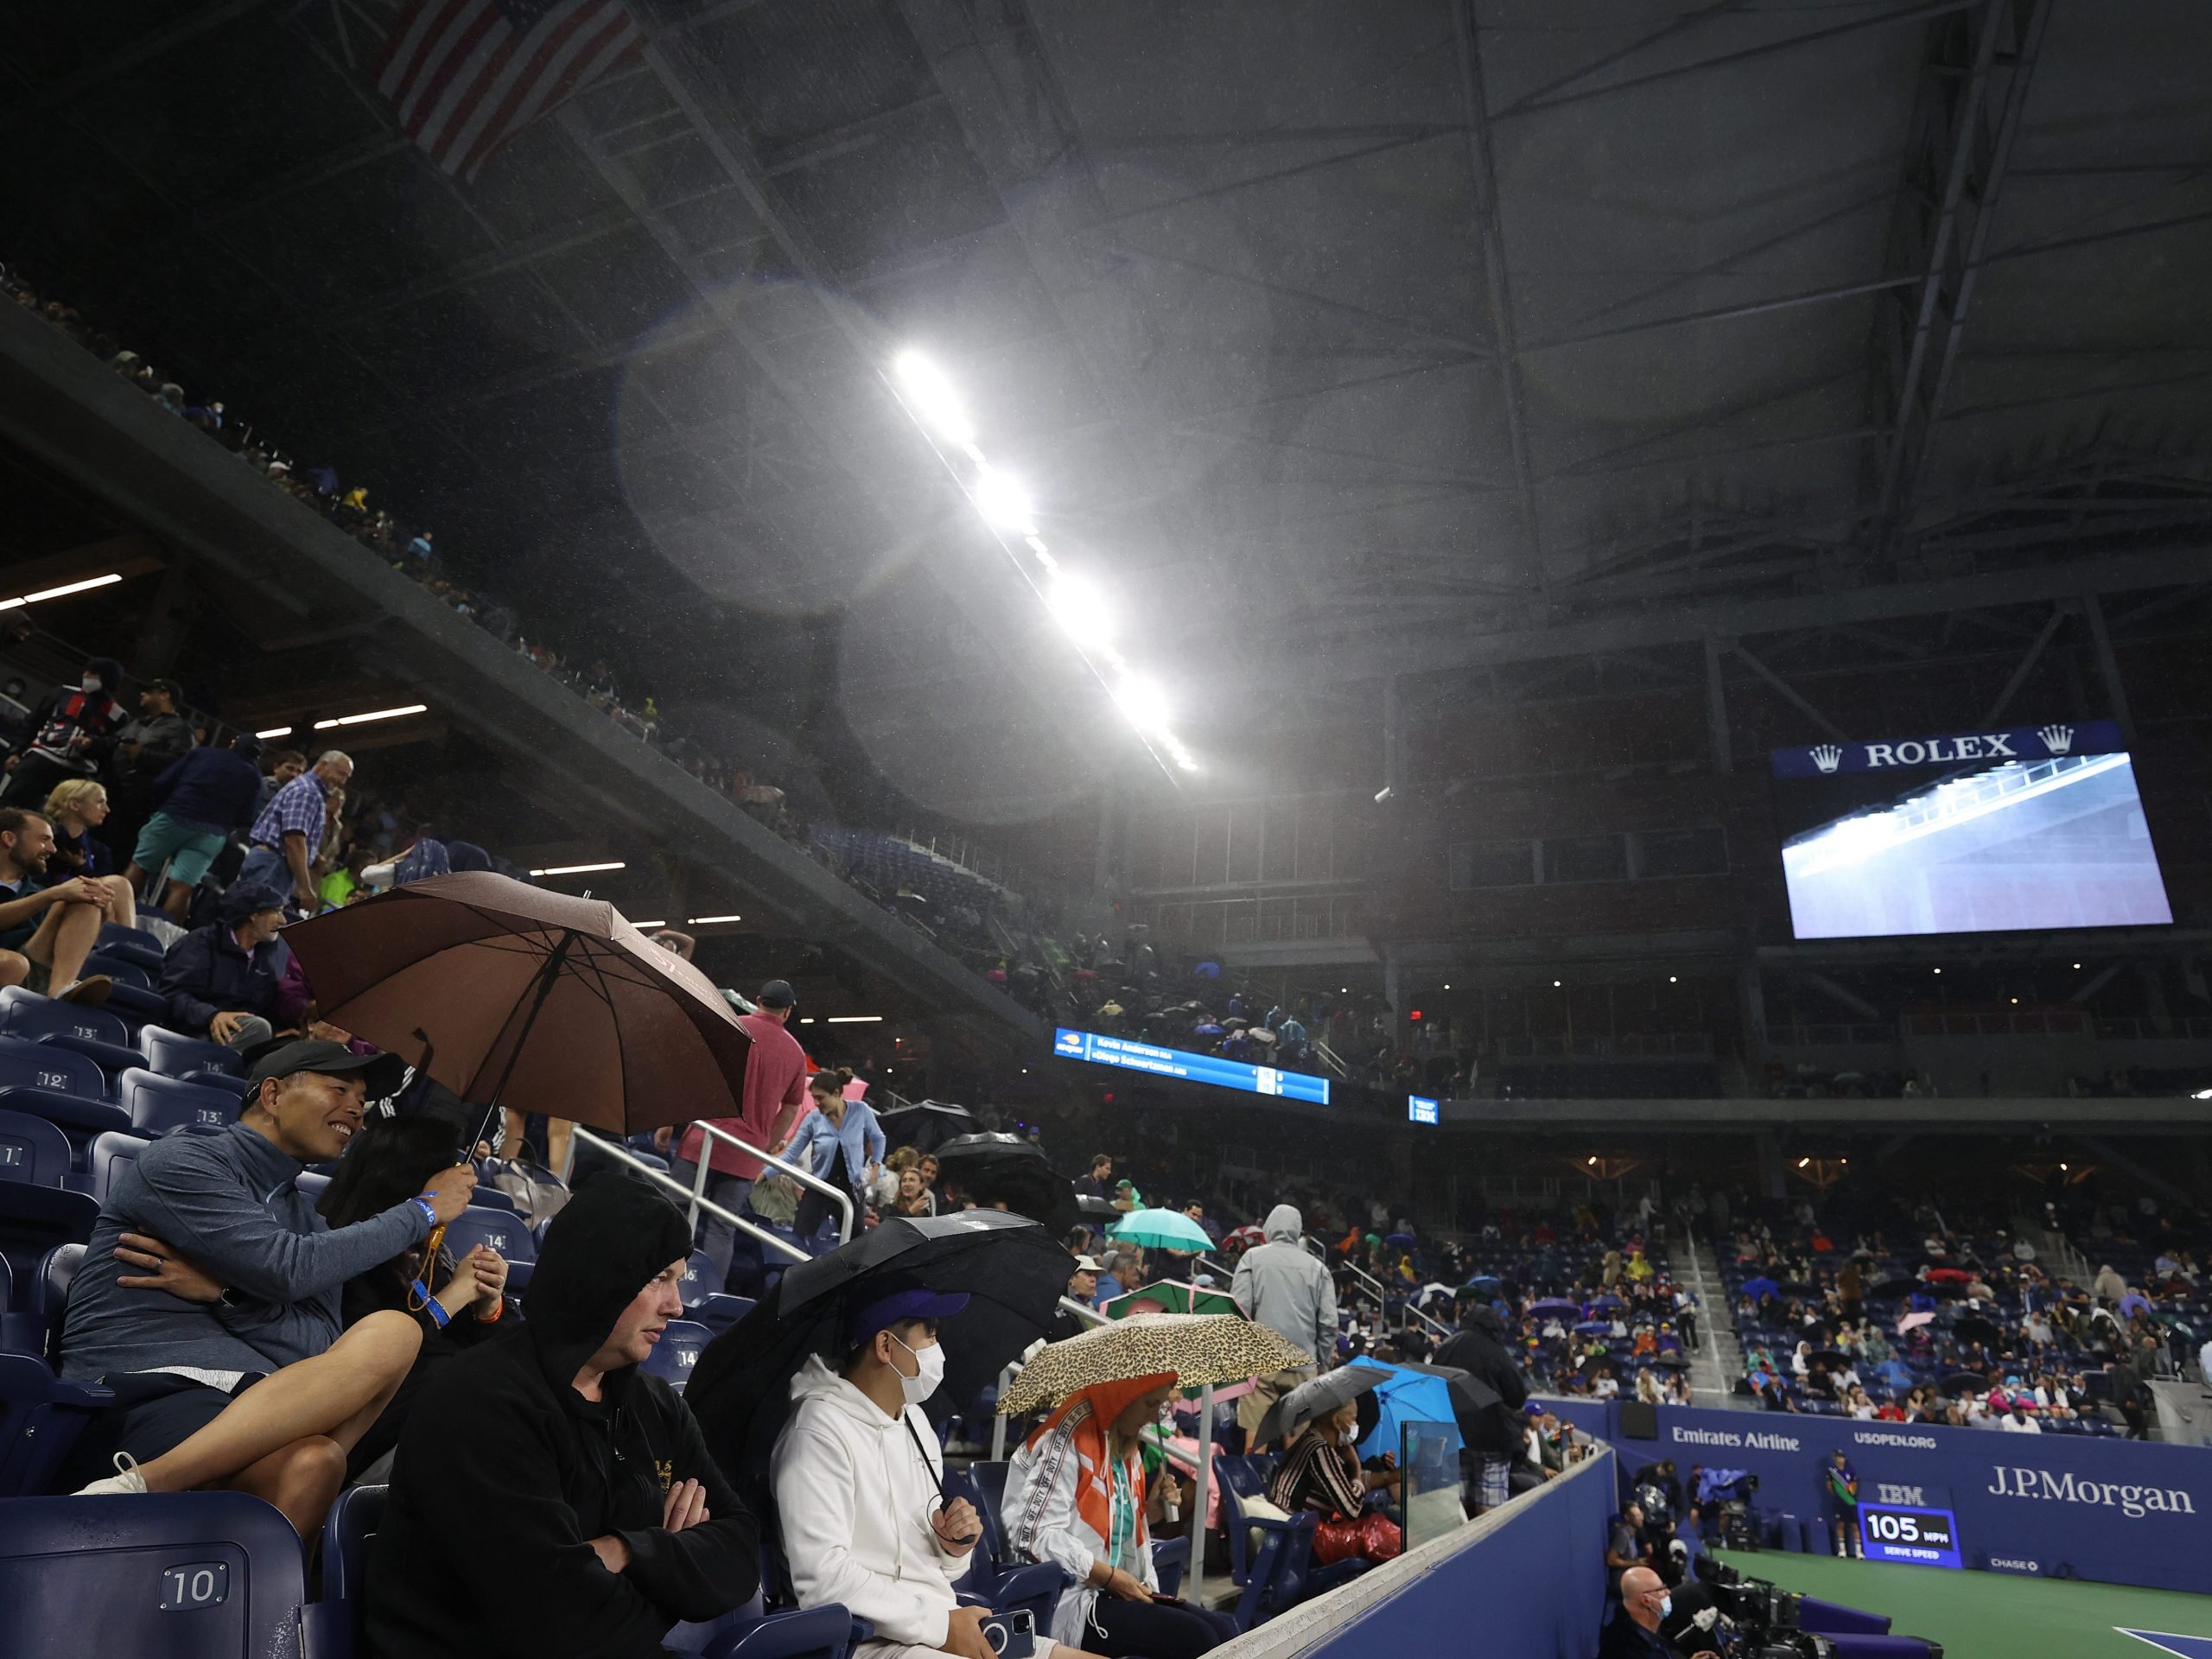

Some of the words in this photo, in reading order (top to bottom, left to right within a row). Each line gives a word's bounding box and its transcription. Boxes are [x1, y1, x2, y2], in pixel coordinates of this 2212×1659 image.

[1864, 734, 2018, 768] ROLEX
[77, 1027, 93, 1039] 13
[1096, 1038, 1121, 1051] Kevin
[1122, 1042, 1159, 1058] Anderson
[43, 1073, 62, 1087] 12
[201, 1110, 218, 1123] 13
[488, 1235, 503, 1248] 14
[680, 1351, 697, 1367] 14
[1672, 1426, 1742, 1447] Emirates
[1745, 1432, 1801, 1452] Airline
[1853, 1432, 1937, 1450] USOPEN.ORG
[1877, 1483, 1928, 1507] IBM
[1987, 1465, 2196, 1518] J.P.Morgan
[1867, 1514, 1920, 1542] 105
[1923, 1530, 1950, 1544] MPH
[1884, 1545, 1911, 1558] SERVE
[1912, 1548, 1941, 1560] SPEED
[1990, 1557, 2028, 1571] CHASE
[174, 1569, 215, 1605] 10
